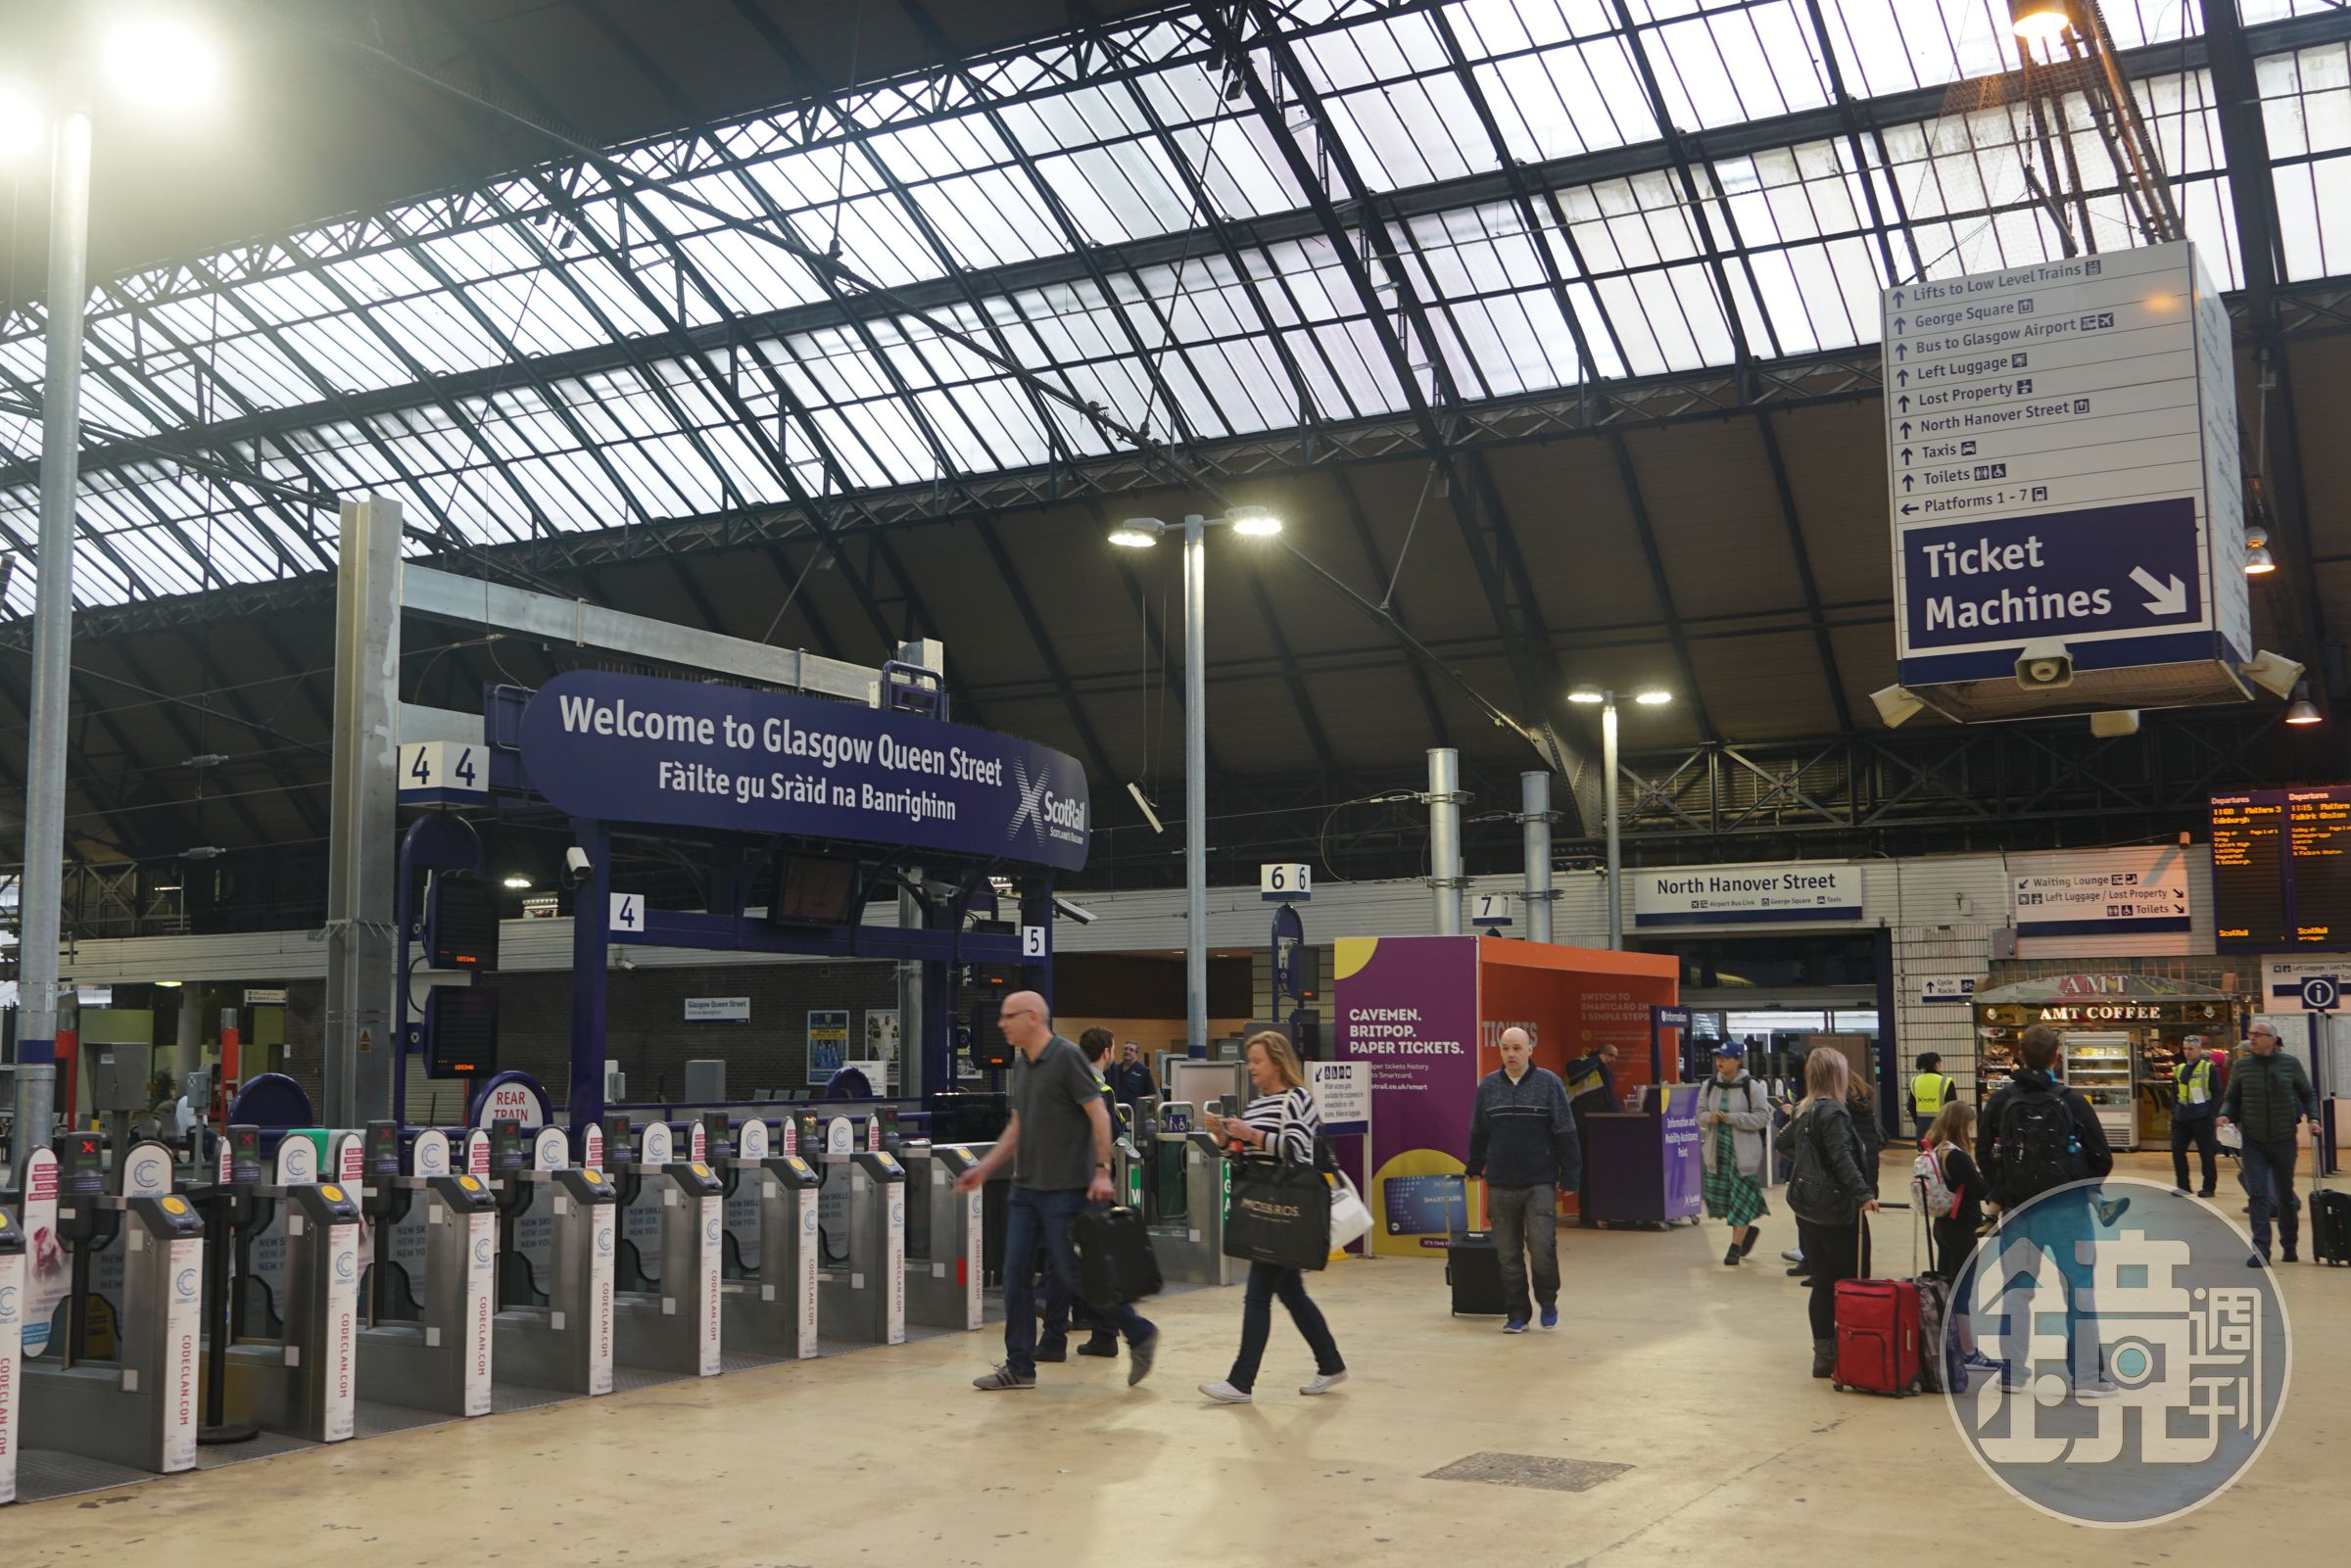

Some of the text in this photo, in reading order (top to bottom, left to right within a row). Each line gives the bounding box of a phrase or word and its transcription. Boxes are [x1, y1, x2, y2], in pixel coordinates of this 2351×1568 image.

[1914, 264, 2081, 301] Lifts to Low Level Trains
[1915, 303, 2013, 328] George Square
[1917, 319, 2076, 354] Bus to Glasgow Airport
[1918, 357, 2007, 380] Left Luggage
[1919, 383, 2012, 406] Lost Property
[1921, 402, 2069, 432] North Hanover Street
[1922, 444, 1956, 458] Taxis
[1924, 469, 1970, 485] Toilets
[1925, 493, 1992, 512] Platforms
[1997, 493, 2004, 504] 1
[2019, 490, 2027, 501] 7
[1923, 536, 2044, 579] Ticket
[1926, 586, 2111, 632] Machines
[559, 694, 1002, 787] Welcome to Glasgow Queen Street
[411, 745, 430, 785] 4
[455, 748, 476, 787] 4
[658, 760, 957, 822] Fàilte gu Sràid na Banrighinn
[2289, 793, 2329, 802] Departures
[1044, 790, 1085, 832] ScotRail
[1271, 866, 1284, 889] 6
[1299, 867, 1306, 890] 6
[1657, 873, 1836, 894] North Hanover Street
[2033, 874, 2109, 887] Waiting Lounge
[2045, 893, 2063, 902] Left
[2065, 891, 2100, 903] Luggage
[2109, 889, 2127, 899] Lost
[2130, 888, 2167, 900] Property
[619, 896, 635, 927] 4
[1481, 897, 1491, 916] 7
[2135, 904, 2169, 914] Toilets
[1031, 929, 1039, 953] 5
[2218, 928, 2249, 937] ScotRail
[2064, 975, 2128, 994] AMT
[689, 1001, 710, 1009] Glasgow
[1349, 1008, 1422, 1021] CAVEMEN.
[2040, 1006, 2161, 1020] AMT COFFEE
[1665, 1012, 1687, 1022] Information
[1350, 1025, 1416, 1038] BRITPOP.
[1350, 1041, 1464, 1054] PAPER TICKETS.
[497, 1092, 526, 1105] REAR
[1667, 1117, 1688, 1128] Information
[1131, 1189, 1141, 1204] W
